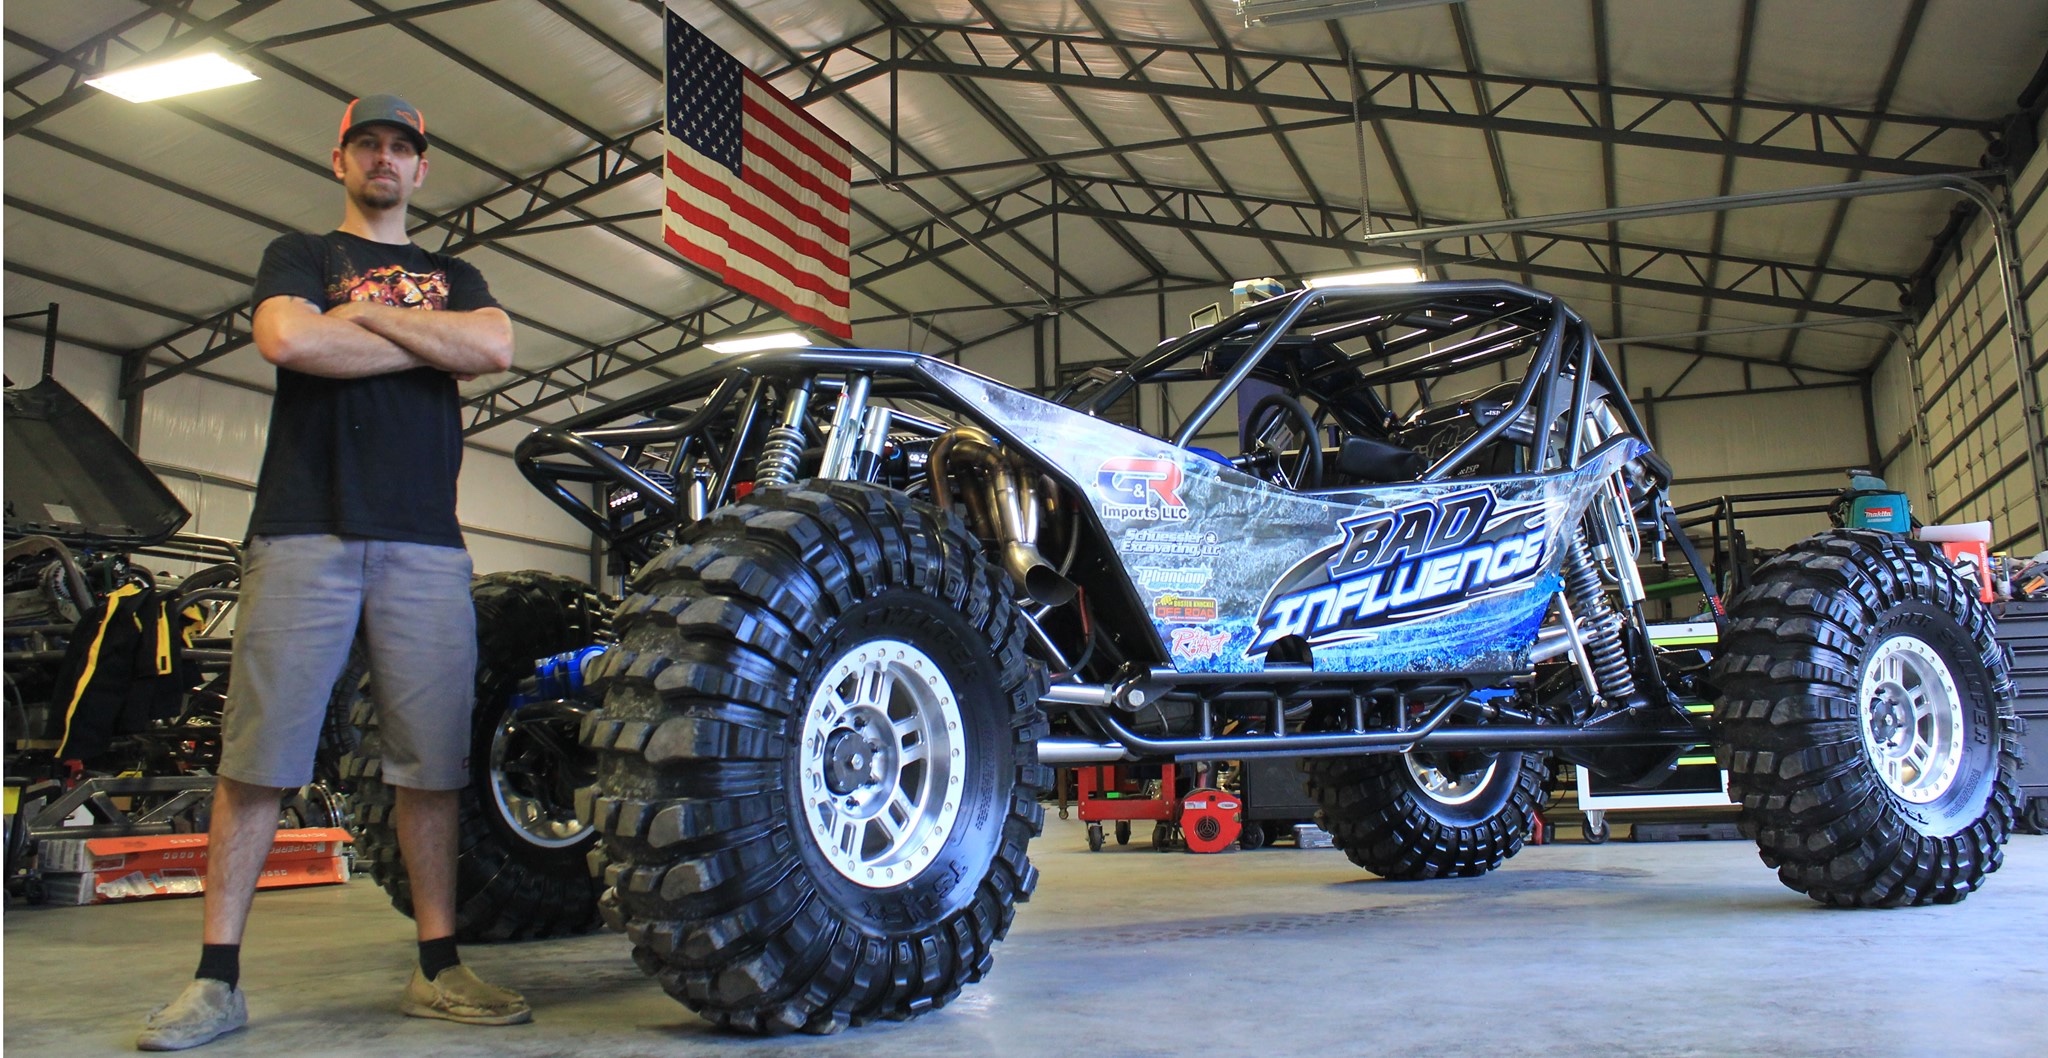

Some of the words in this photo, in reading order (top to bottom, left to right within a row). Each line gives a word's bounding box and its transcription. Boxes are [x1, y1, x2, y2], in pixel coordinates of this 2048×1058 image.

[1103, 505, 1158, 520] Imports
[1162, 507, 1188, 520] LLC
[1125, 529, 1204, 544] Schuessler
[1330, 490, 1496, 578] BAD
[1121, 539, 1202, 557] Excavating,
[1138, 568, 1206, 585] Phantom
[1259, 528, 1546, 645] INFLUENCE
[1156, 607, 1182, 617] OFF
[1184, 607, 1215, 617] ROAD
[1940, 627, 1989, 745] SWAMPER
